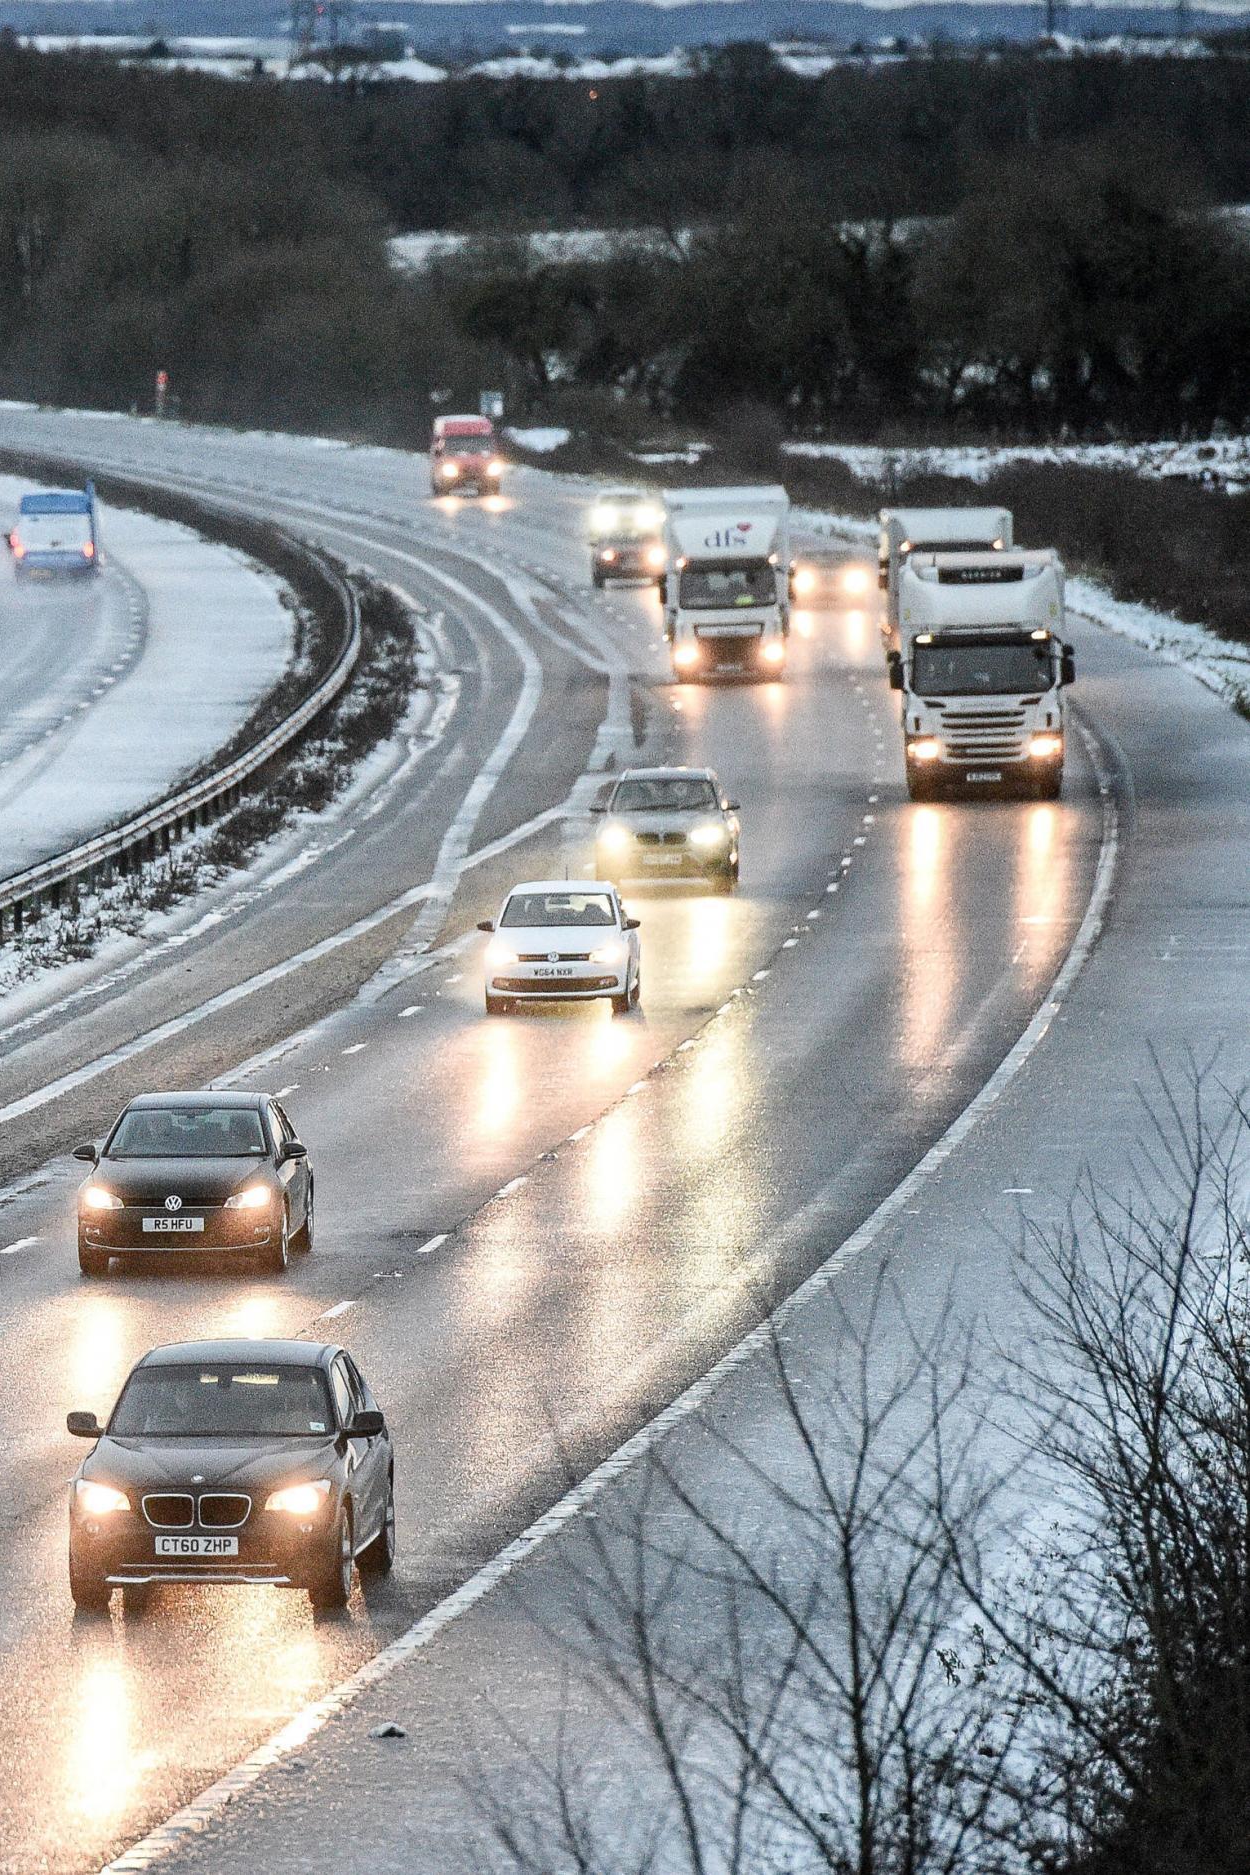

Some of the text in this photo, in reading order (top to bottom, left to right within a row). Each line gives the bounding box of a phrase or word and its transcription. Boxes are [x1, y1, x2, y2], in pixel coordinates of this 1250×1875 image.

[704, 527, 747, 548] dfs
[171, 1219, 193, 1230] HFU
[161, 1539, 232, 1553] CT60 ZHP
